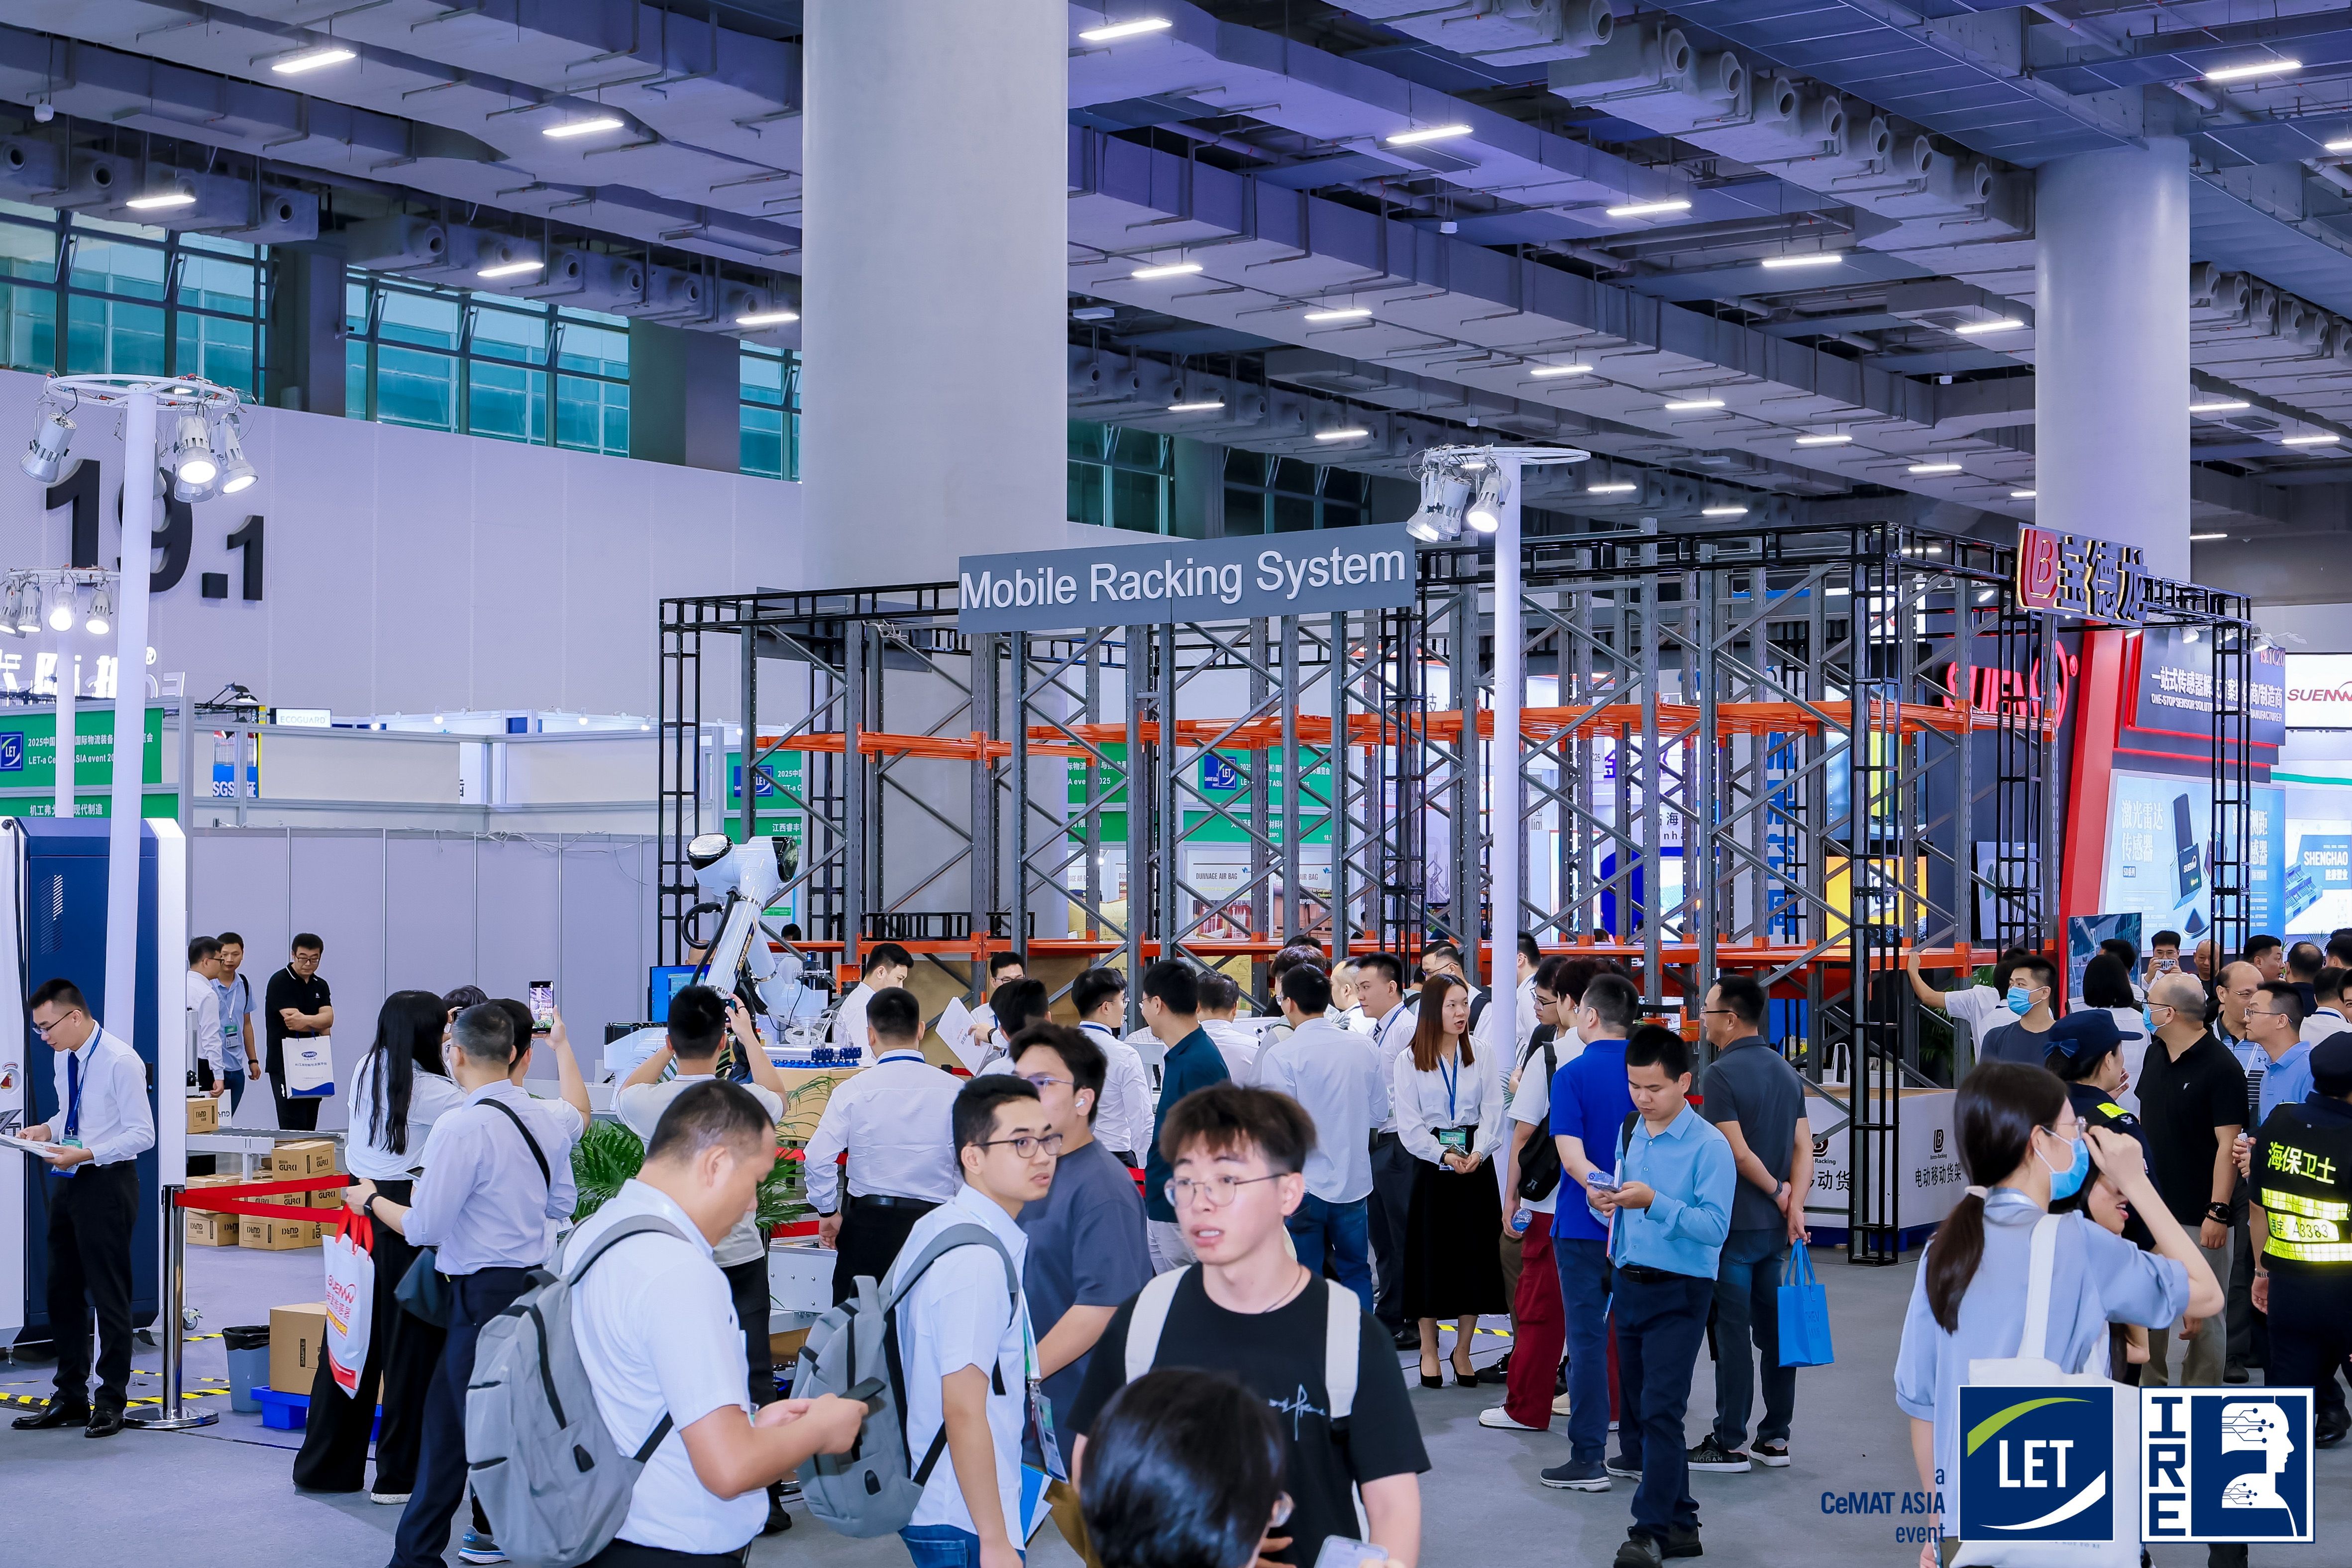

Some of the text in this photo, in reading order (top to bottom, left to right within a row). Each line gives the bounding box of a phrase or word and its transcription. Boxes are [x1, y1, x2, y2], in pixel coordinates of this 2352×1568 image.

[46, 459, 264, 601] 19.1
[961, 546, 1405, 610] Mobile Racking System
[2055, 534, 2148, 623] 宝德龙
[2151, 693, 2175, 707] ONE-STOP
[2176, 697, 2195, 710] SENSOR
[5, 746, 16, 757] LET
[74, 754, 87, 763] SIA
[88, 753, 106, 762] event
[1222, 768, 1231, 778] LET
[2121, 800, 2163, 831] 激光雷达
[2122, 832, 2153, 862] 传感器
[2304, 851, 2349, 866] SHENGHAO
[1916, 1162, 1962, 1188] 电动移动货架
[2267, 1142, 2336, 1184] 海保卫士
[2293, 1221, 2329, 1238] A3383
